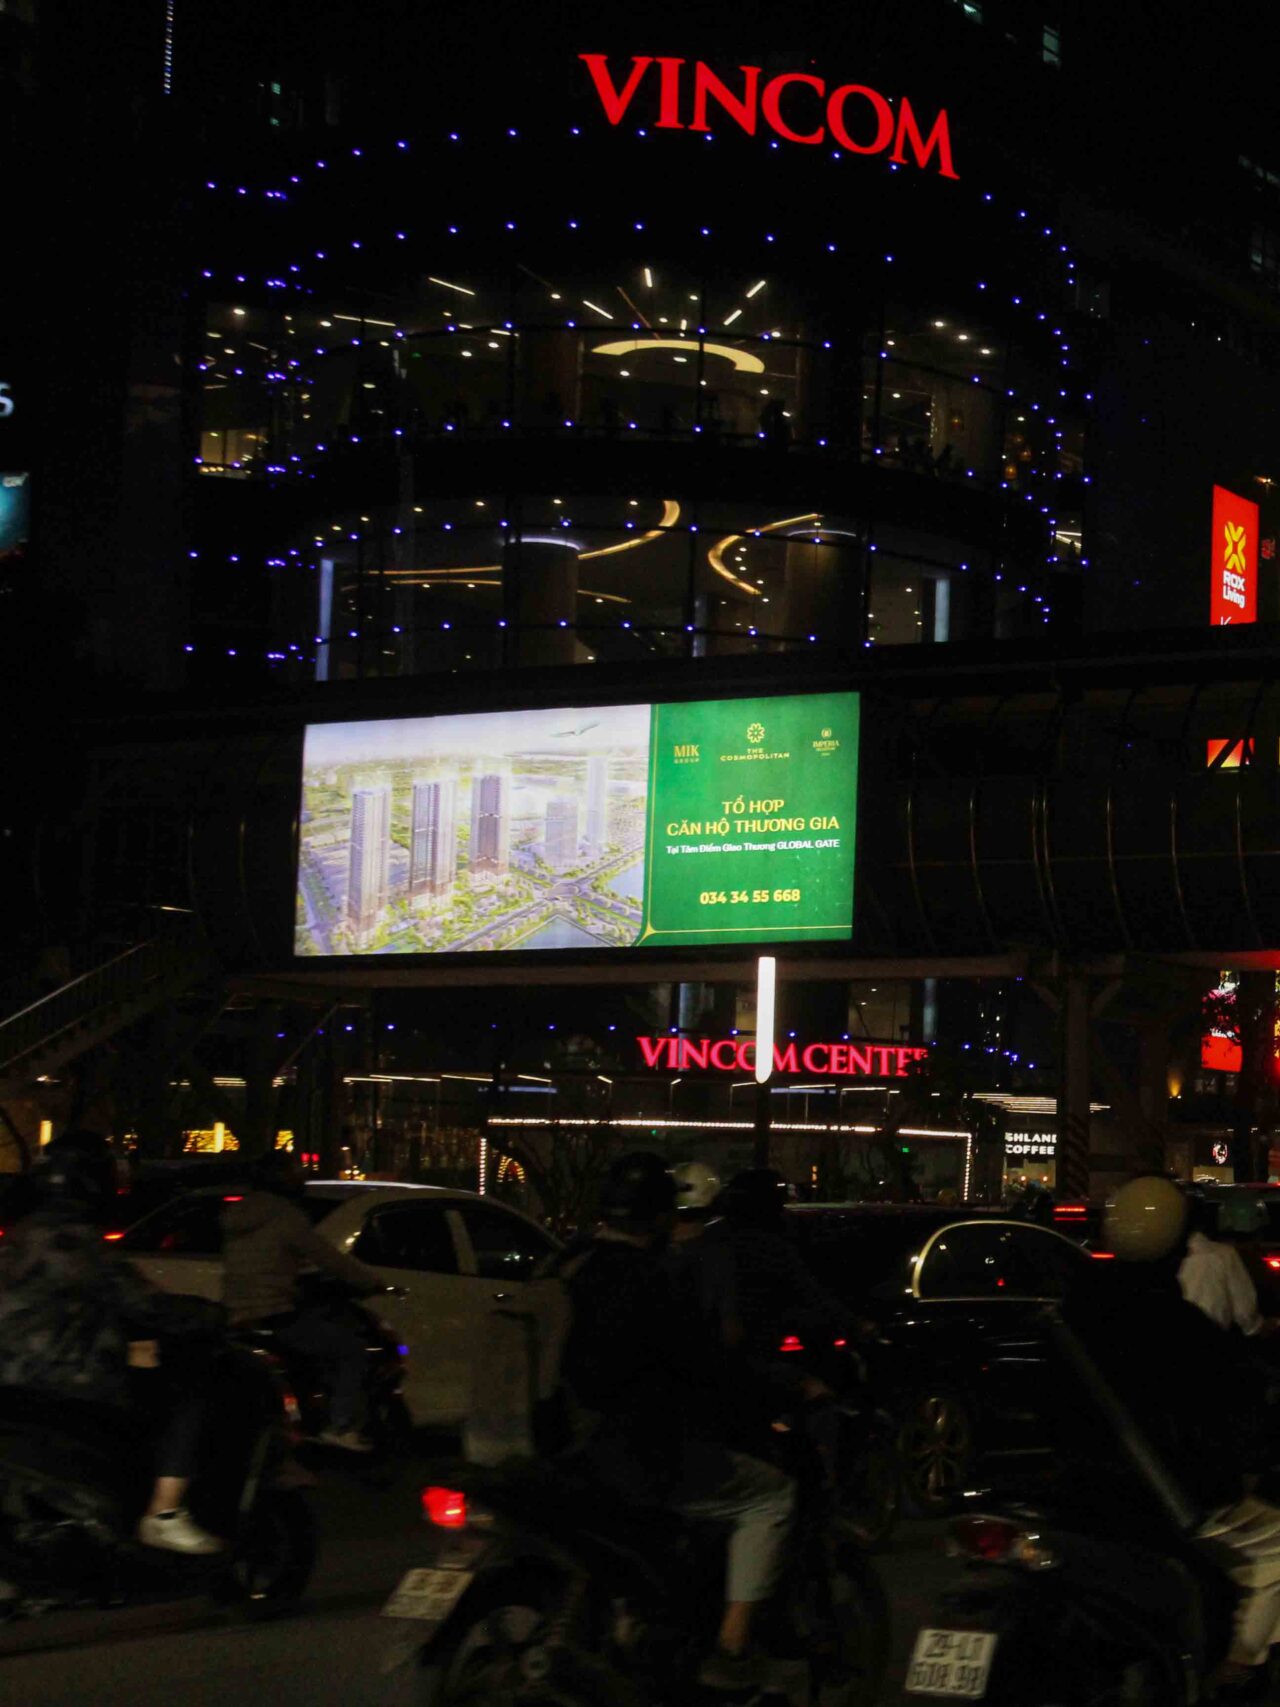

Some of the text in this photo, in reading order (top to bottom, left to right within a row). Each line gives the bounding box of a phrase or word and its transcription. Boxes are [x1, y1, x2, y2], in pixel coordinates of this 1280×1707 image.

[577, 53, 961, 180] VINCOM
[1222, 570, 1245, 591] ROX
[1222, 587, 1245, 609] Living
[674, 745, 699, 757] MIK
[720, 752, 790, 762] COSMOPOLITAN
[722, 795, 785, 815] TỔ HỢP
[666, 816, 840, 836] CĂN HỘ THƯƠNG GIA
[777, 840, 814, 850] GLOBAL
[815, 839, 840, 848] GATE
[700, 889, 801, 905] 034 34 55 668
[1005, 1144, 1055, 1155] COFFEE
